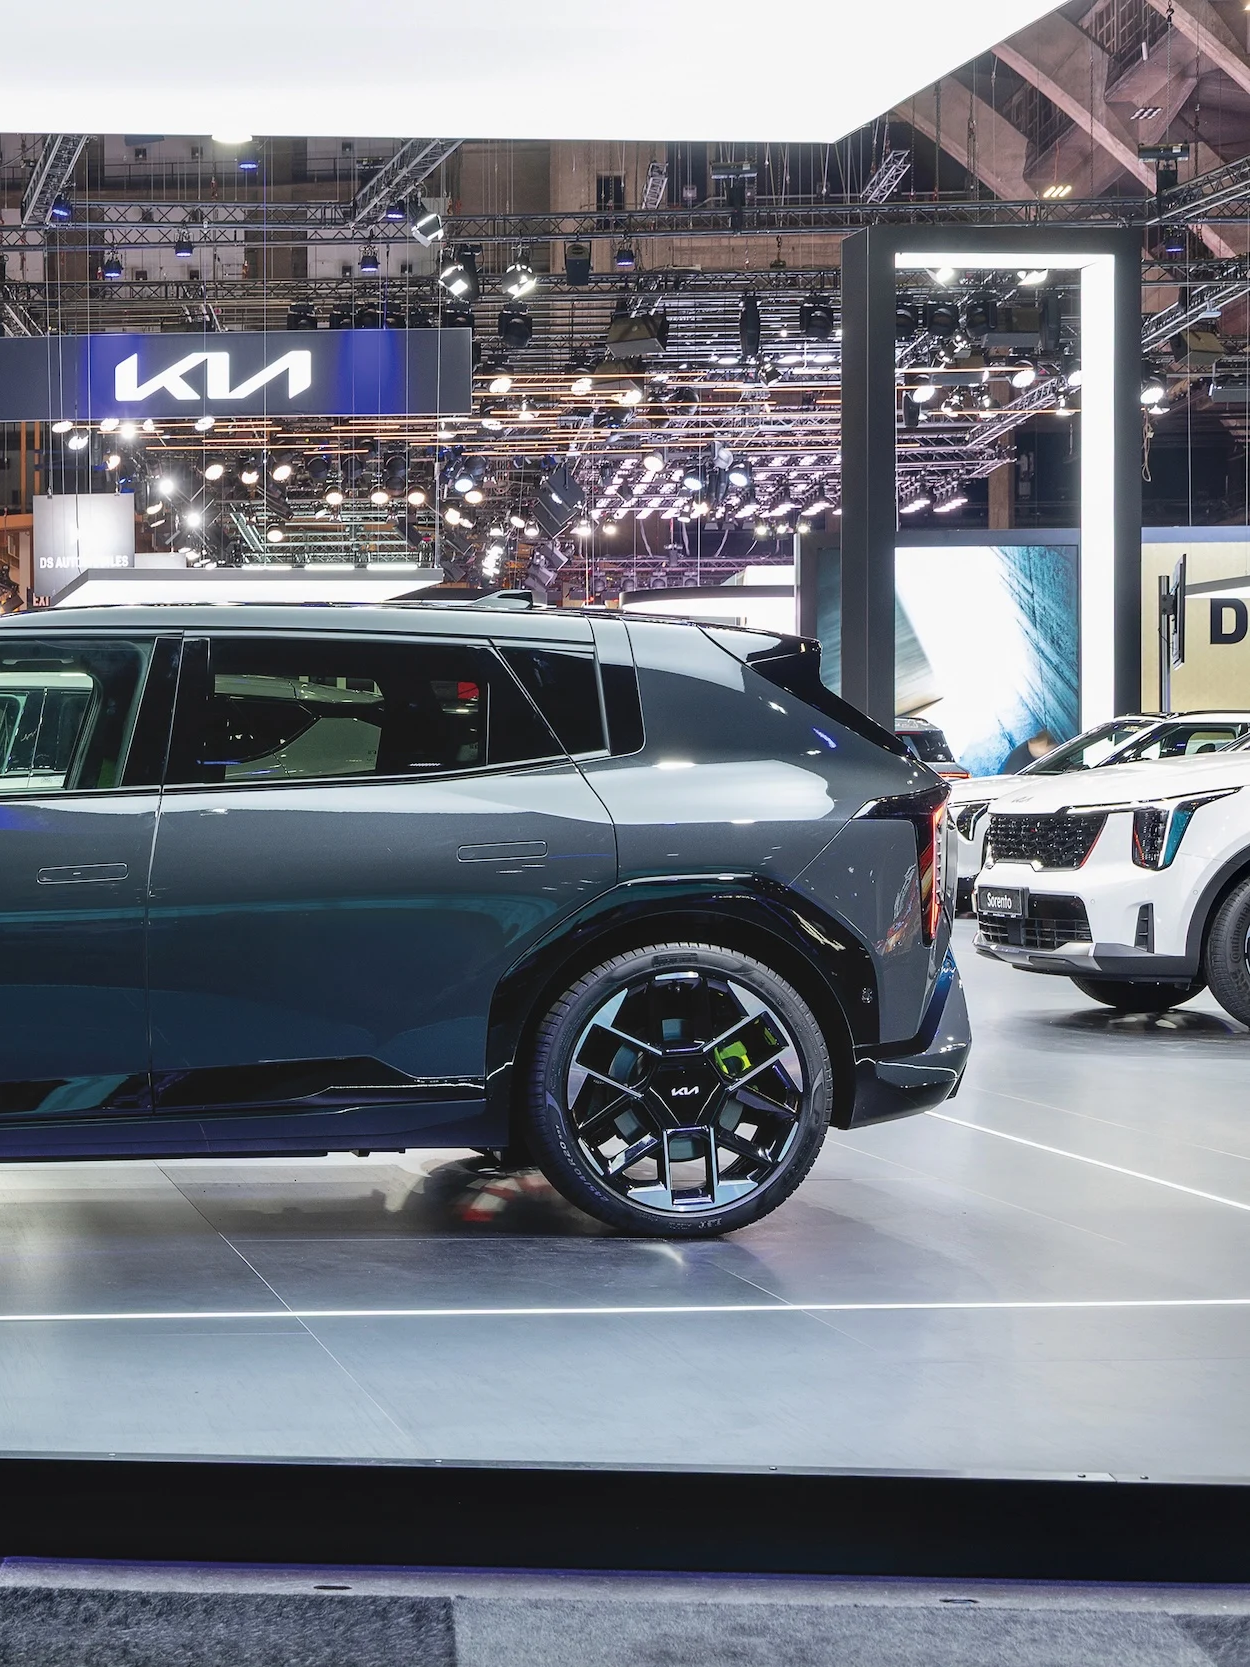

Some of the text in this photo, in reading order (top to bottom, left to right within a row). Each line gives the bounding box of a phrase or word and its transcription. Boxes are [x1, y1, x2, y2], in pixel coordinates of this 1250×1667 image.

[115, 350, 311, 402] KIA
[40, 555, 129, 569] DS AUTLES
[33, 594, 49, 606] EXI
[1210, 598, 1248, 644] D
[987, 892, 1012, 909] Sorento
[671, 1086, 699, 1096] KIA
